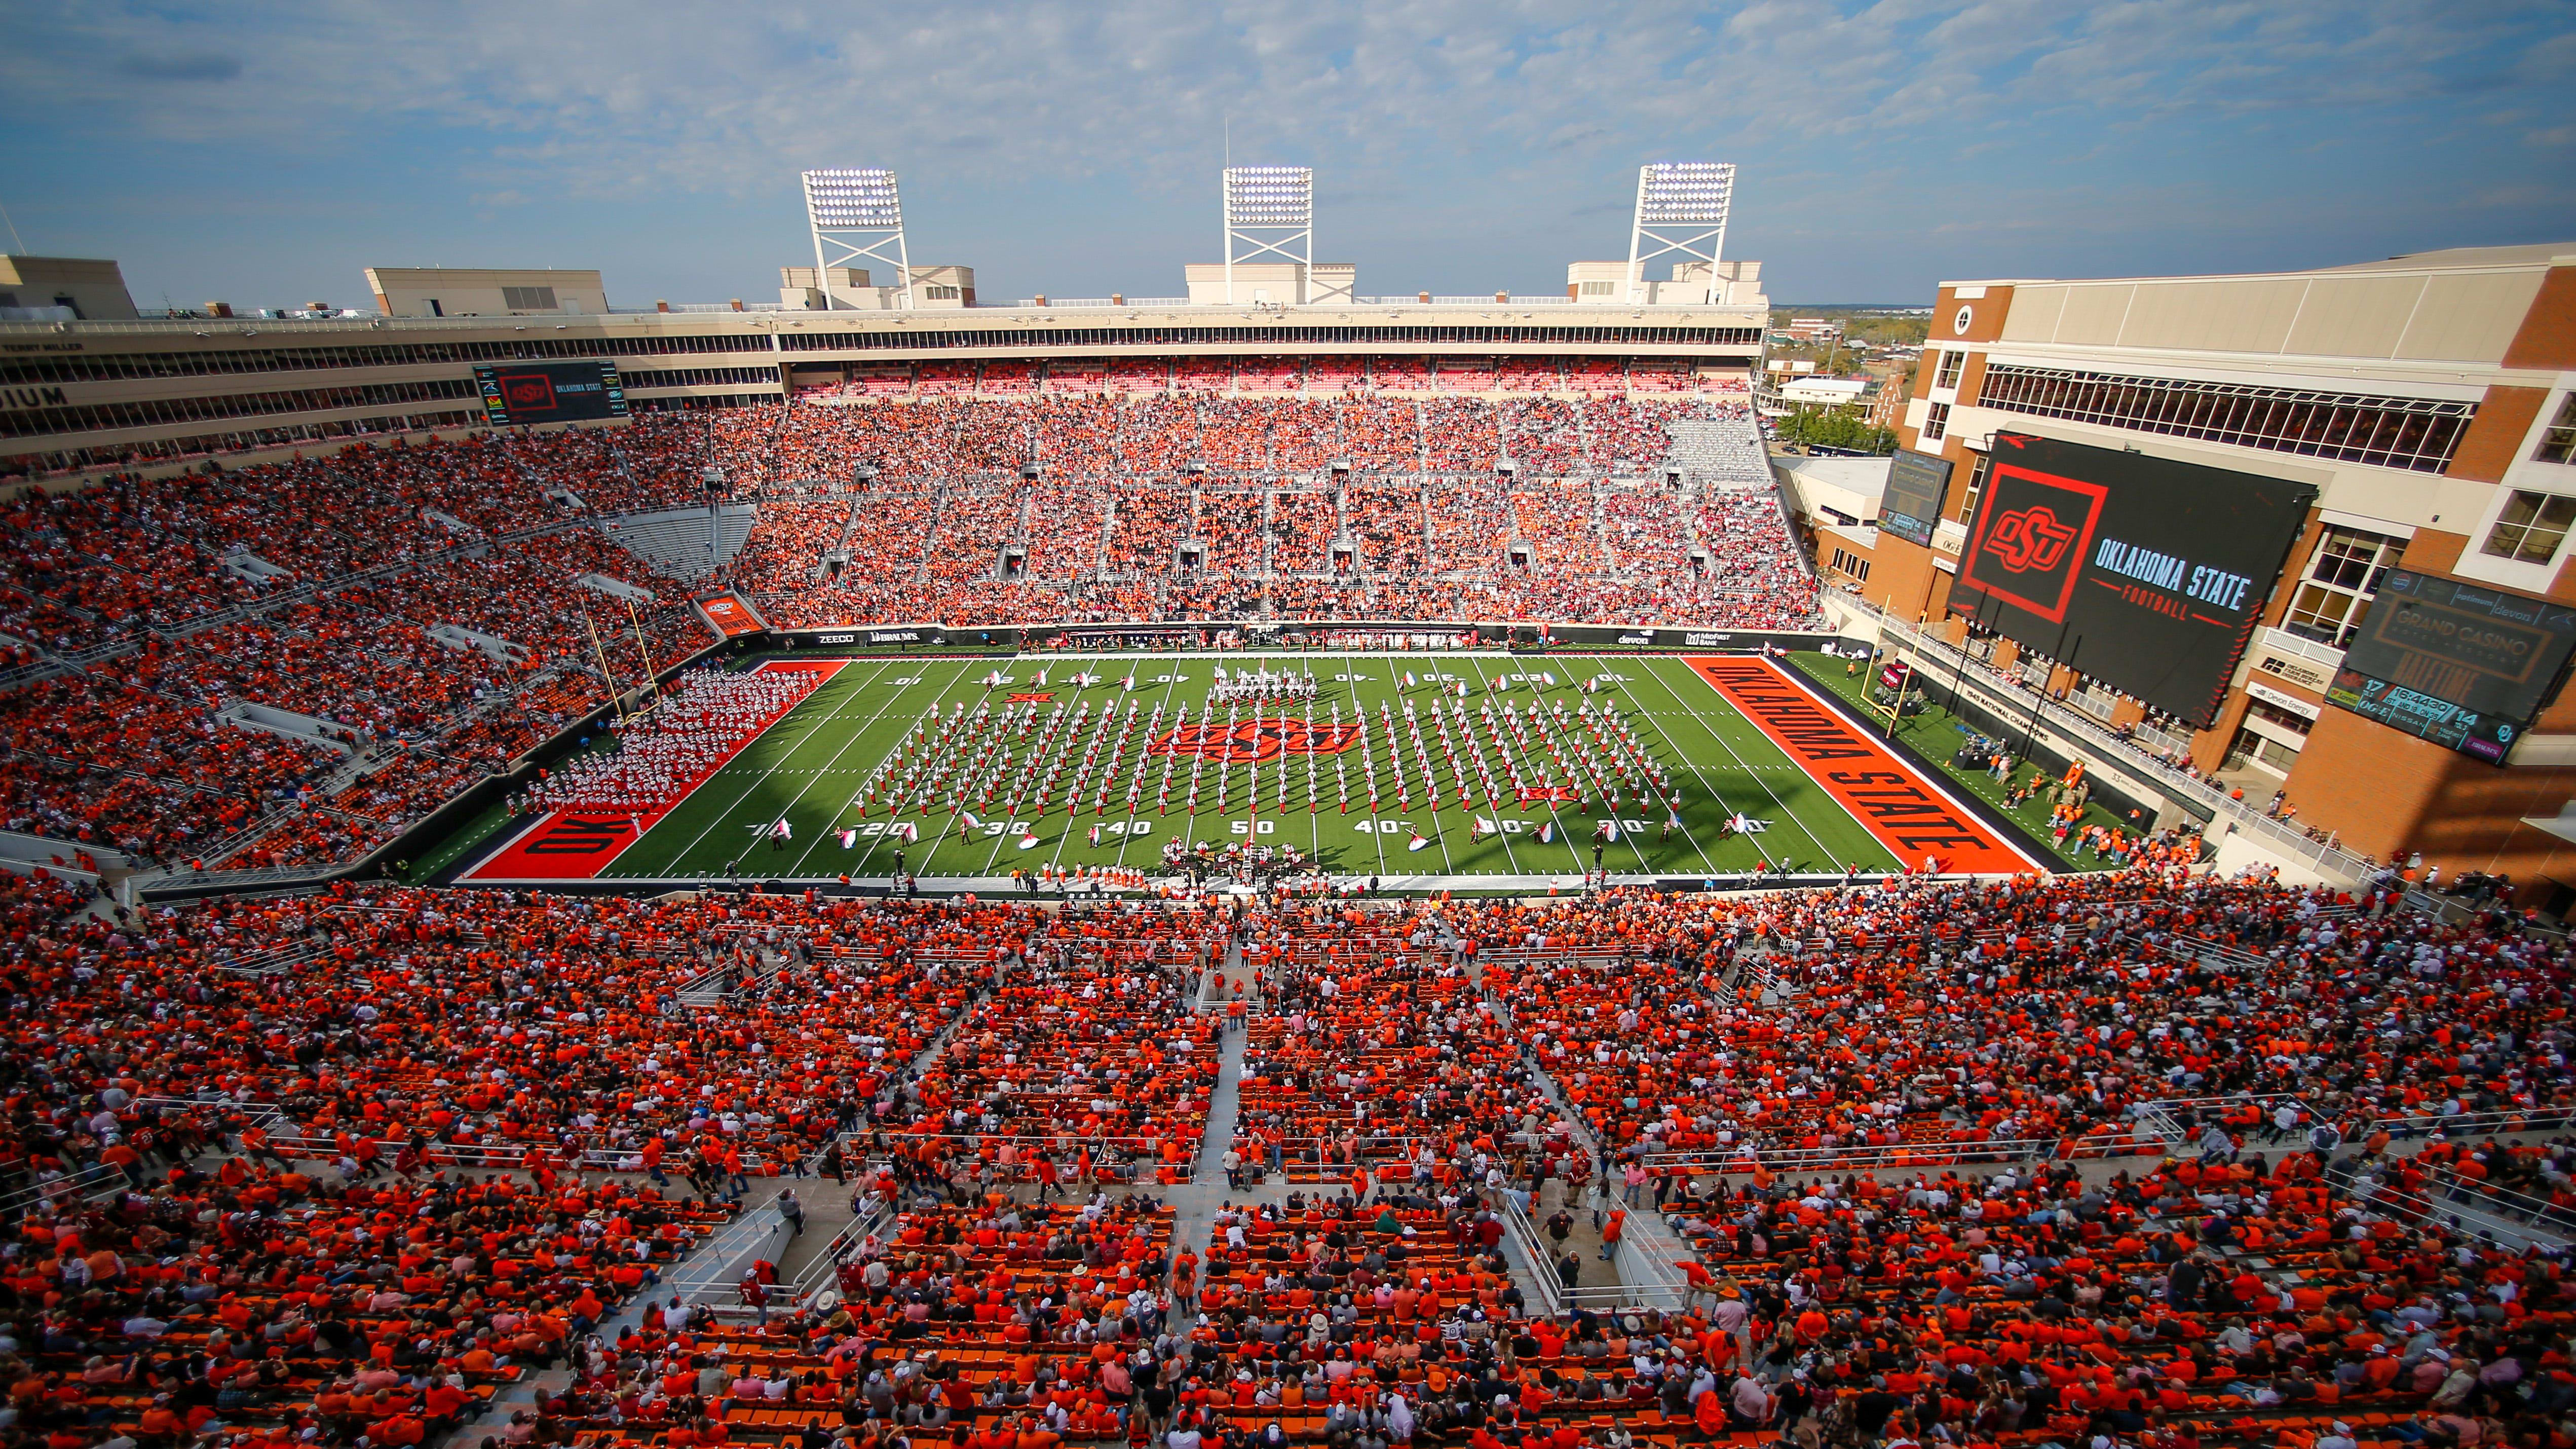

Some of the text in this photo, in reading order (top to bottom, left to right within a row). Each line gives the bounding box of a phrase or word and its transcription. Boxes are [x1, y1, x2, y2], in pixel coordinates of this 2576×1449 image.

[556, 384, 585, 393] OKLAHOMA
[0, 387, 68, 408] IUM
[1983, 506, 2077, 573] OSU
[2095, 538, 2186, 592] OKLAHOMA
[2186, 565, 2252, 612] STATE
[2121, 584, 2188, 621] FOOTBALL
[2455, 593, 2494, 607] optimum
[2494, 605, 2532, 622] devon
[819, 635, 853, 644] ZEECO
[1618, 635, 1649, 645] devon
[2396, 610, 2528, 655] GRAND CASINO
[1961, 616, 1990, 635] GARY
[2013, 641, 2071, 673] CLAUDIA
[2081, 673, 2181, 726] HUMPHREYS
[2287, 663, 2319, 678] OKLAHOMA
[2391, 651, 2481, 704] HALFTIME
[2366, 679, 2385, 692] 17
[1966, 690, 1980, 701] 1945
[1980, 697, 2010, 720] NATIONAL
[2267, 692, 2310, 716] Devon Energy
[2398, 701, 2410, 710] AND
[1706, 665, 1875, 760] OKLAHOMA
[2456, 710, 2478, 726] 14
[2392, 713, 2426, 729] NISSAN
[2111, 772, 2121, 783] 33
[1827, 771, 1991, 851] STATE
[1107, 821, 1152, 835] 40
[1230, 820, 1274, 834] 50
[1353, 820, 1398, 834] 40
[1465, 1228, 1472, 1236] 7
